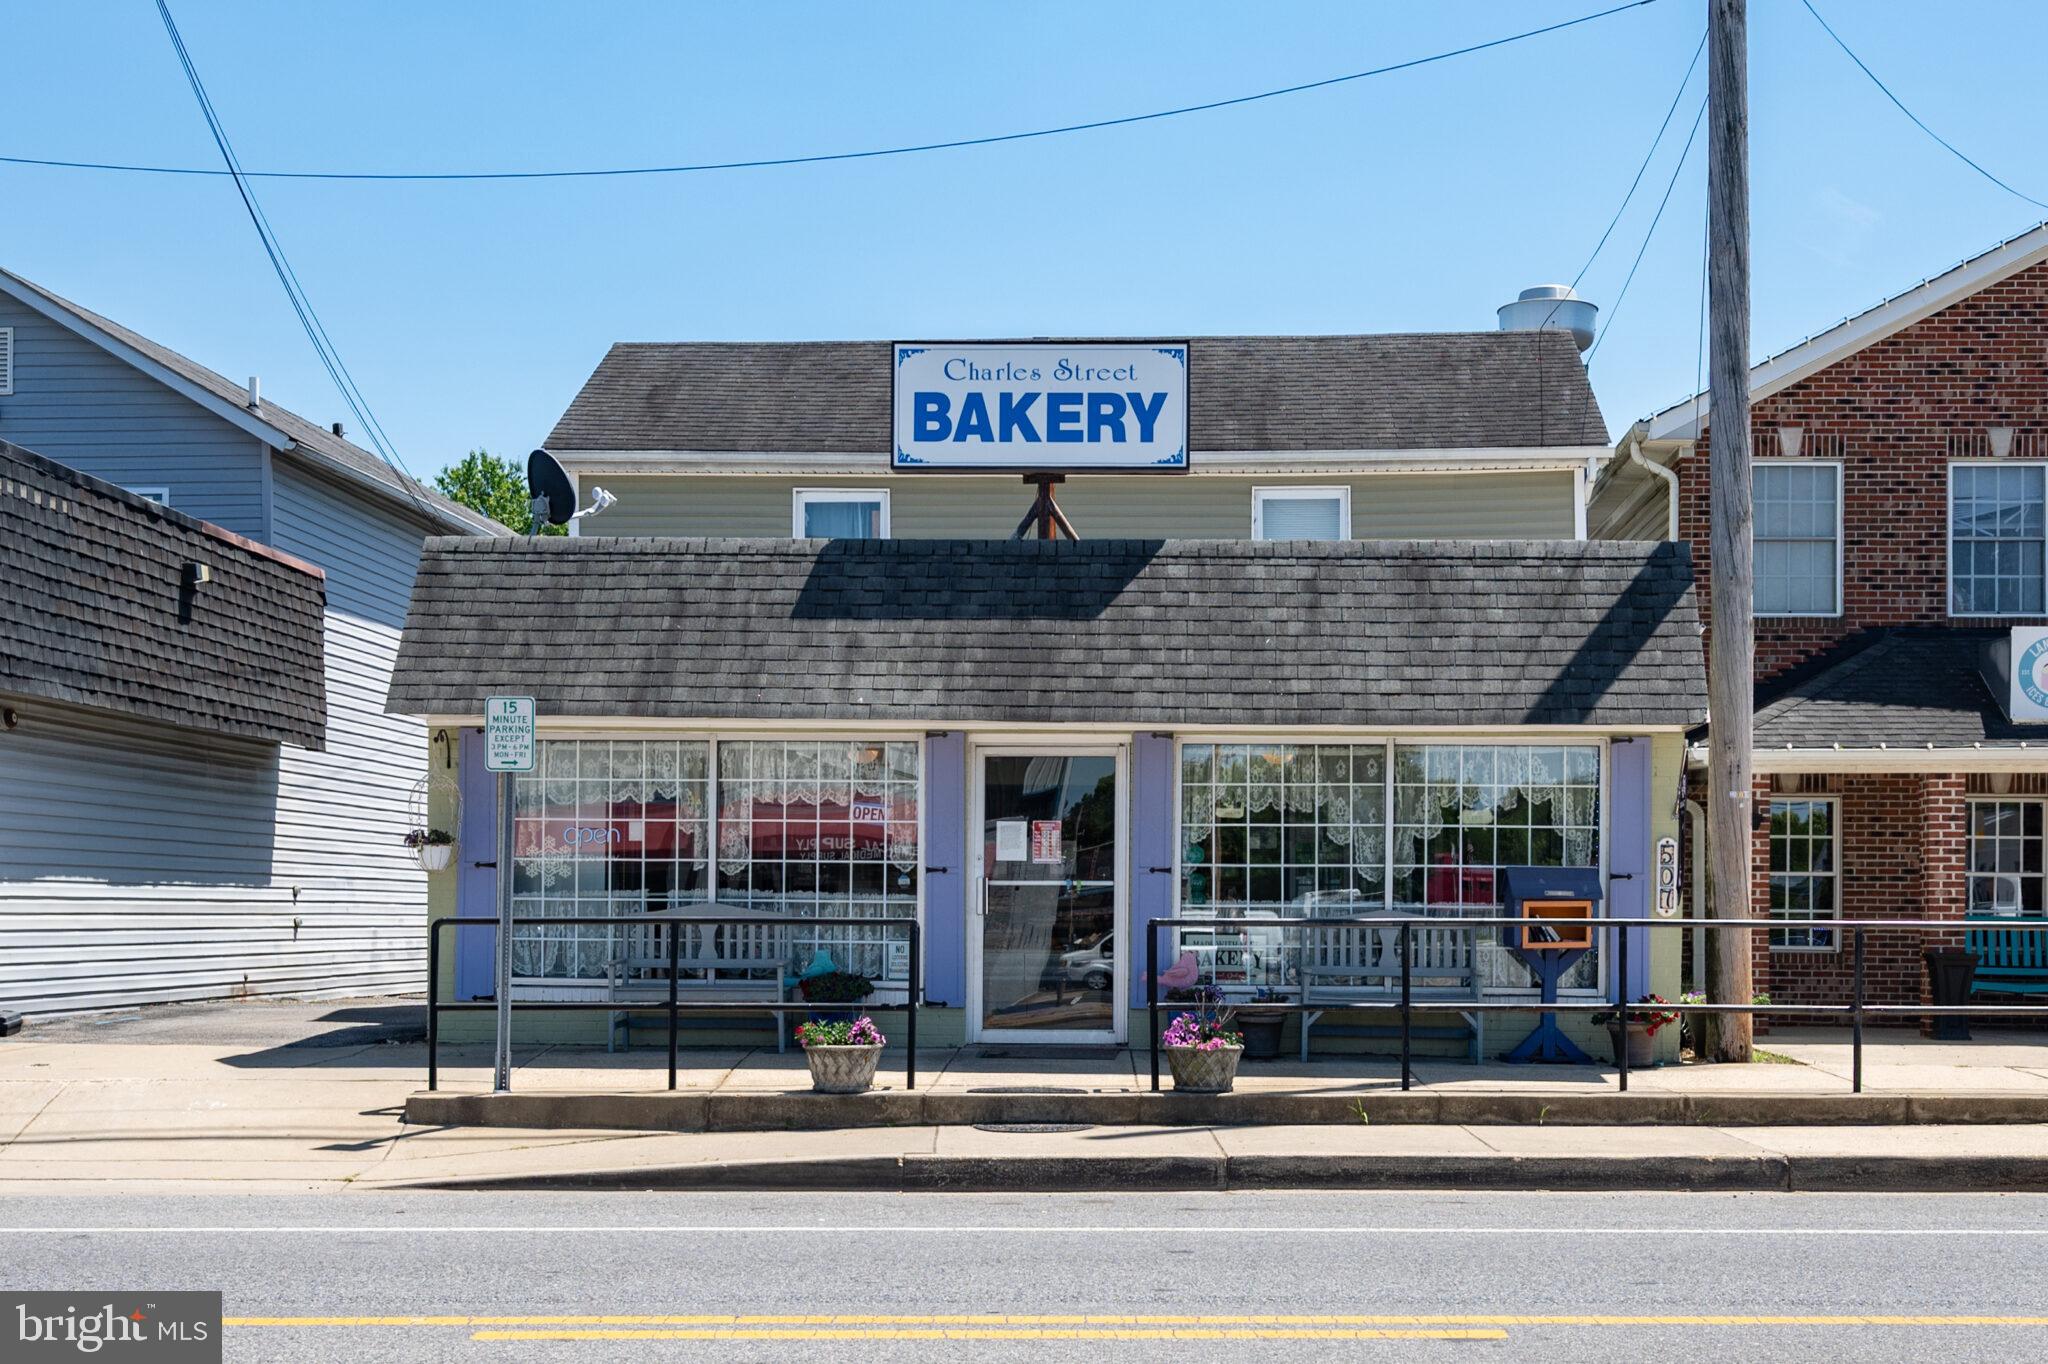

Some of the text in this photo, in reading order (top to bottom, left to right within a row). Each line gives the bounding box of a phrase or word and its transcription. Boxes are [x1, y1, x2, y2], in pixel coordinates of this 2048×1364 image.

[943, 358, 1138, 381] Charles Street
[913, 391, 1169, 443] BAKERY
[503, 701, 518, 714] 15
[492, 715, 528, 724] MINUTE
[489, 725, 531, 733] PARKING
[494, 735, 525, 743] EXCEPT
[853, 806, 885, 821] OPEN
[563, 827, 621, 848] open
[1660, 844, 1674, 909] 507
[895, 945, 905, 954] NO
